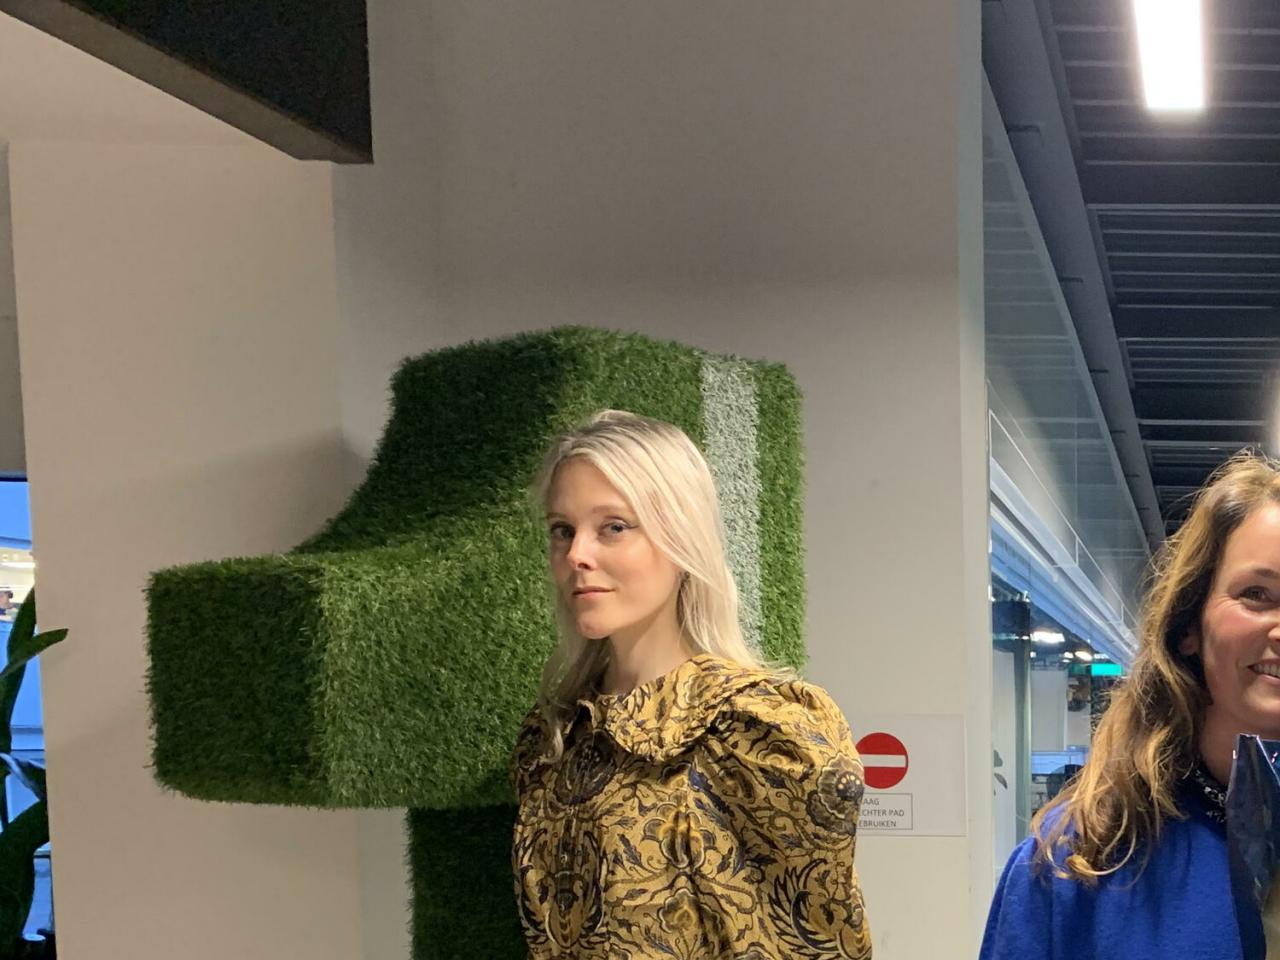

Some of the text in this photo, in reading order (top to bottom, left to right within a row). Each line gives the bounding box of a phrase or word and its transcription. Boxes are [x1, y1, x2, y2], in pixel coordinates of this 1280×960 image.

[863, 798, 879, 806] AAG
[861, 809, 904, 817] CHTER PAD
